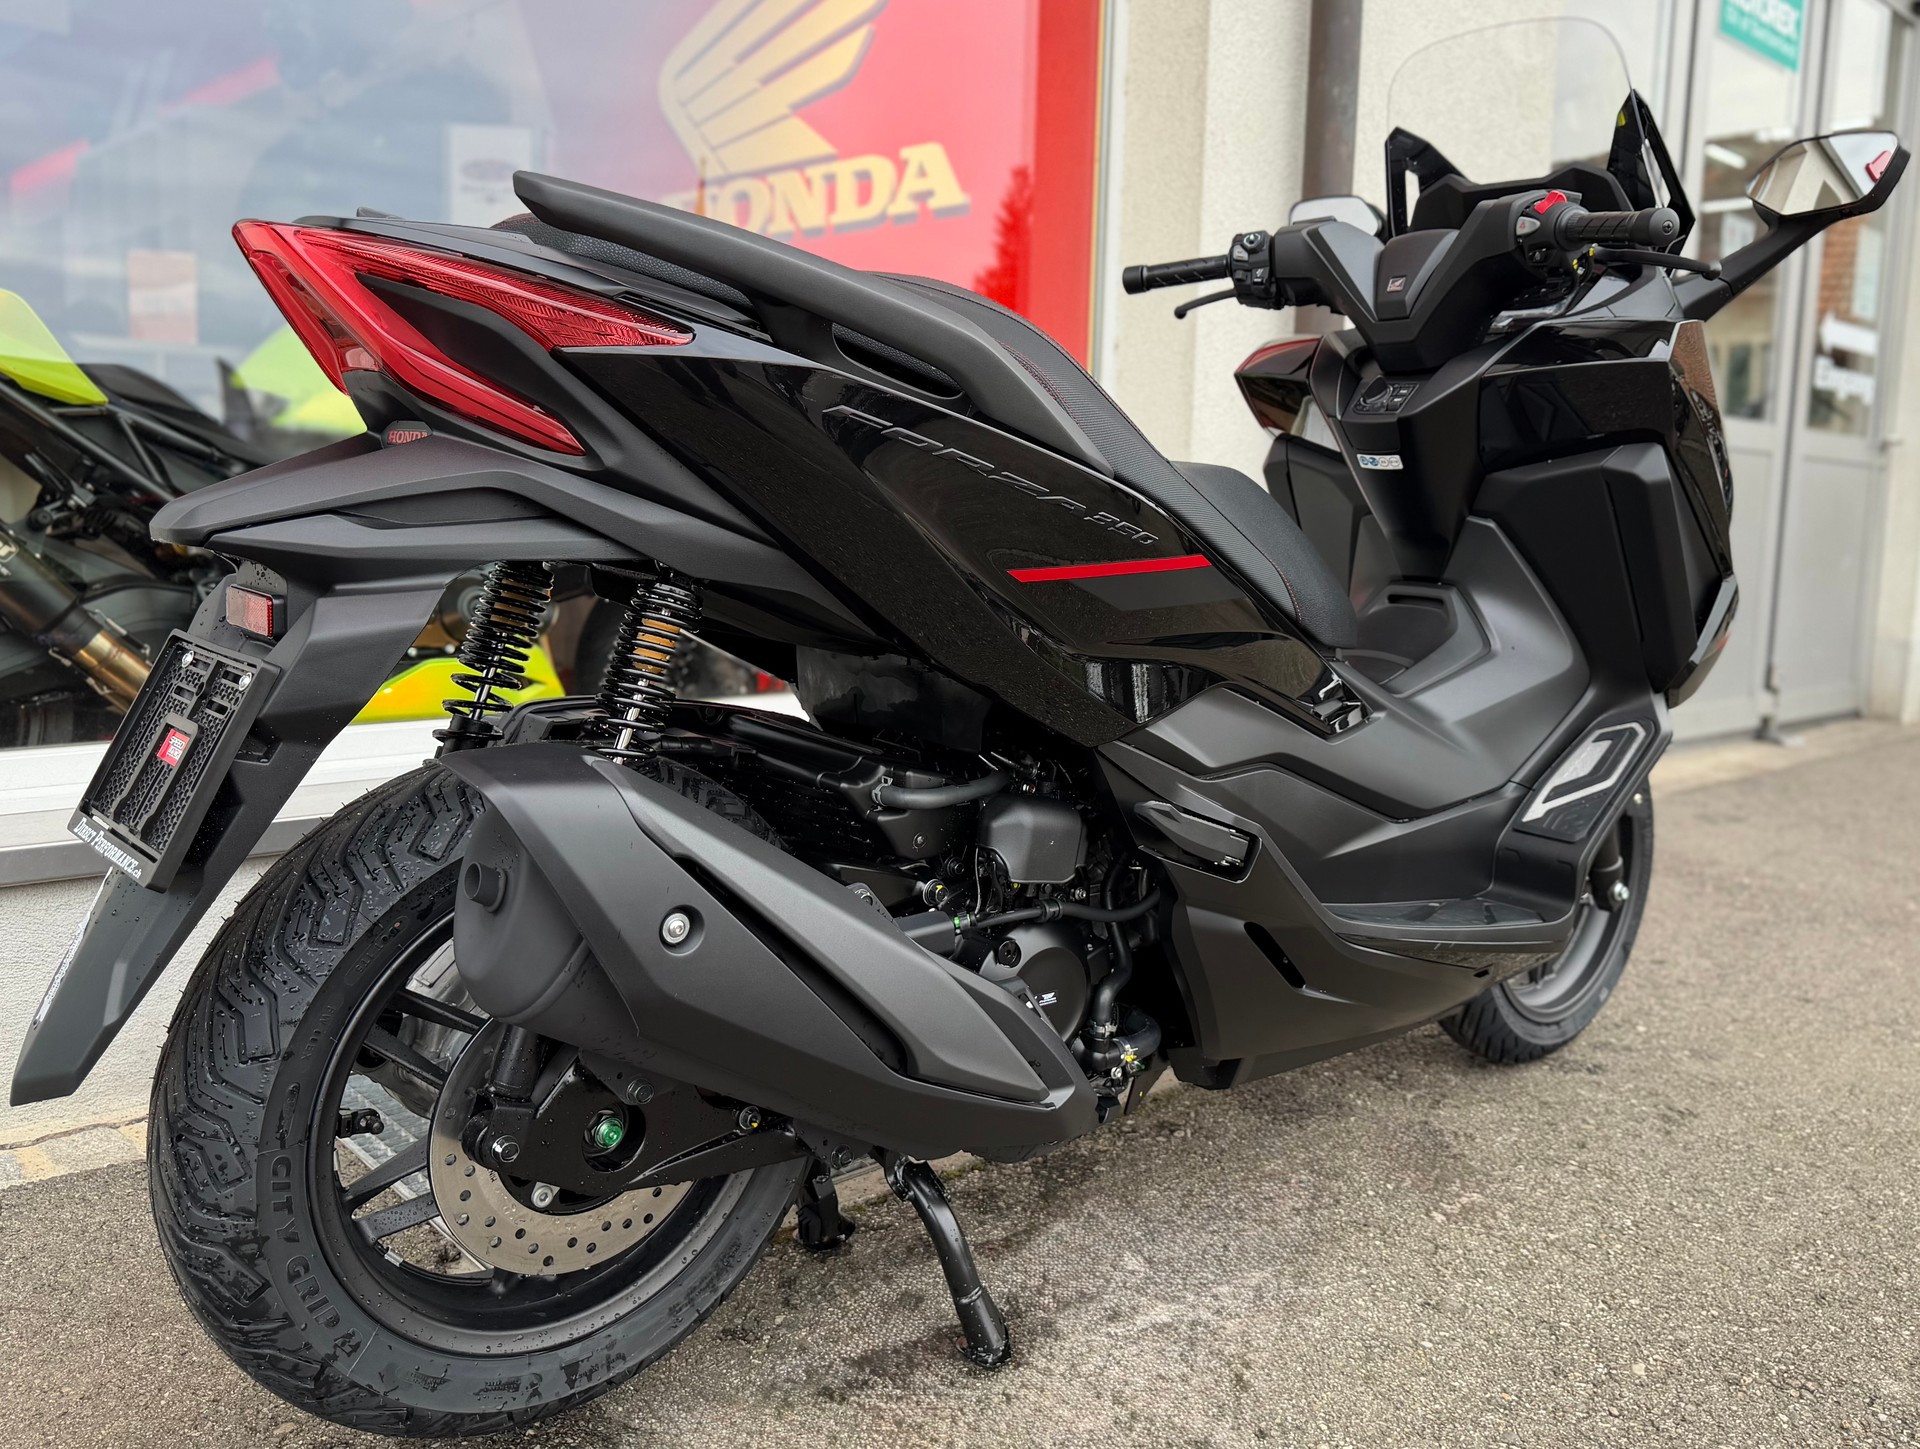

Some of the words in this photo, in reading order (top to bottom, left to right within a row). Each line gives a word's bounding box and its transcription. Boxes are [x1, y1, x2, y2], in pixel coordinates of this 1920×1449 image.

[822, 404, 1087, 514] FORZA
[73, 817, 97, 843] DIRECT
[91, 830, 142, 879] PERFORMANCE.ch
[271, 1155, 300, 1242] CITY
[286, 1255, 341, 1328] GRIP
